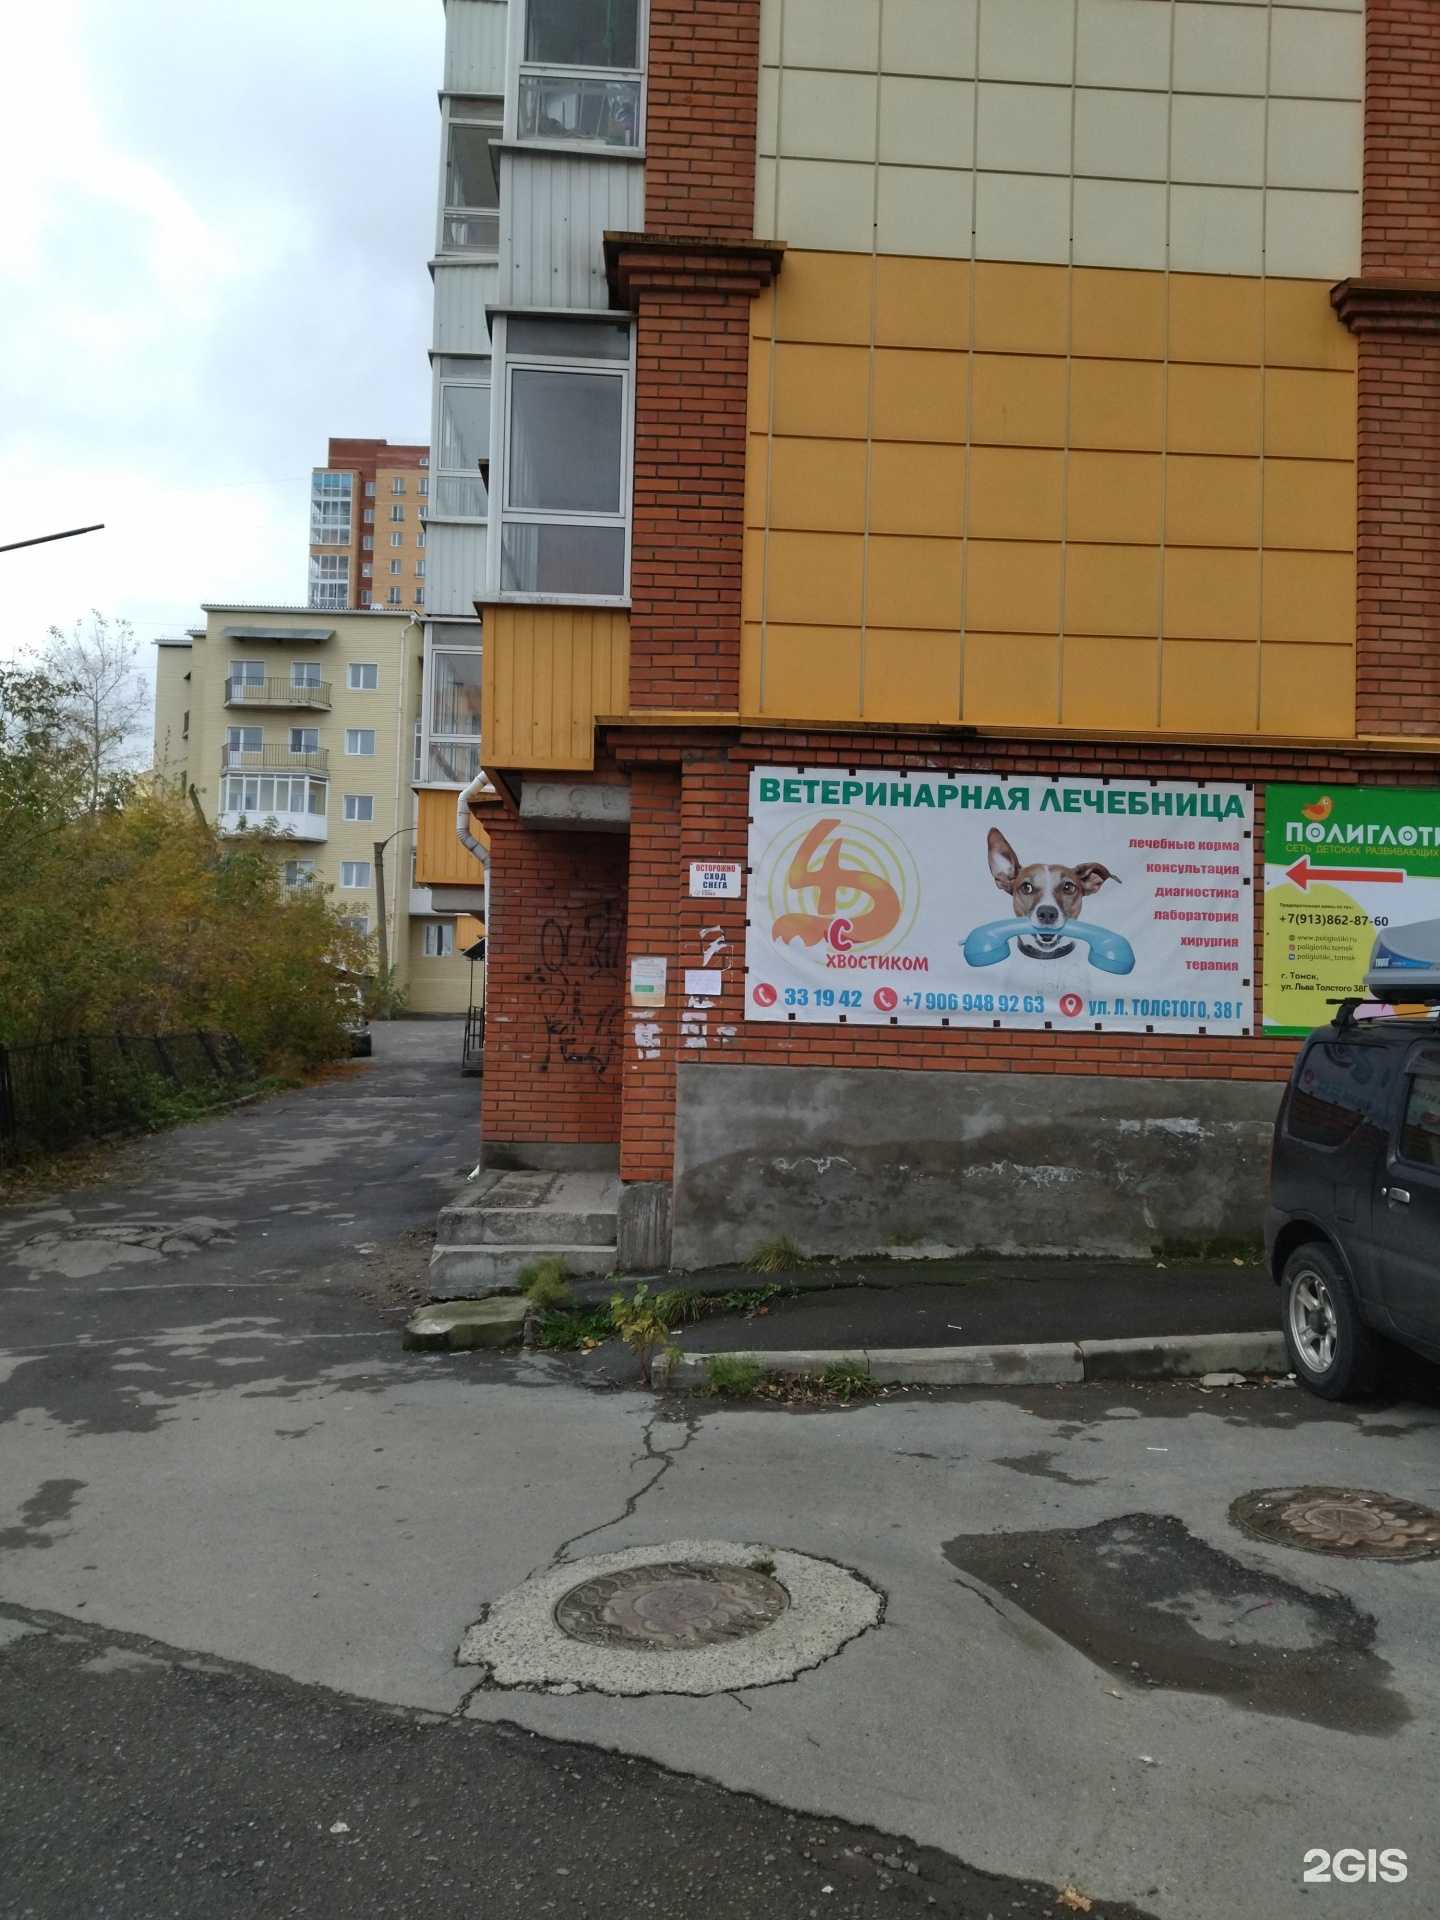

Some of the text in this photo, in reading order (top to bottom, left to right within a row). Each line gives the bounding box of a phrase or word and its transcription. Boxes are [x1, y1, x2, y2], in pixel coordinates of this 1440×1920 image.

[760, 778, 1245, 822] ВЕТЕРИНАРНАЯ ЛЕЧЕБНИЦА
[1128, 838, 1240, 852] лечебные корма
[695, 864, 736, 872] ОСТОРОЖНО
[1146, 863, 1240, 875] консультация
[704, 872, 727, 881] СХОД
[702, 881, 728, 889] СНЕГА
[1154, 887, 1240, 899] диагностика
[1153, 910, 1239, 922] лаборатория
[1279, 913, 1389, 927] +7(913)862-87-60
[1180, 937, 1239, 948] хирургия
[826, 954, 929, 972] ХВОСТИКОМ
[1184, 961, 1239, 971] терапия
[1281, 984, 1292, 992] ул.
[1315, 984, 1352, 993] Толстого
[784, 987, 862, 1008] 33 19 42
[902, 992, 1045, 1014] +7 906 948 92 63
[1088, 1000, 1111, 1017] ул.
[1132, 998, 1211, 1020] ТОЛСТОГО,
